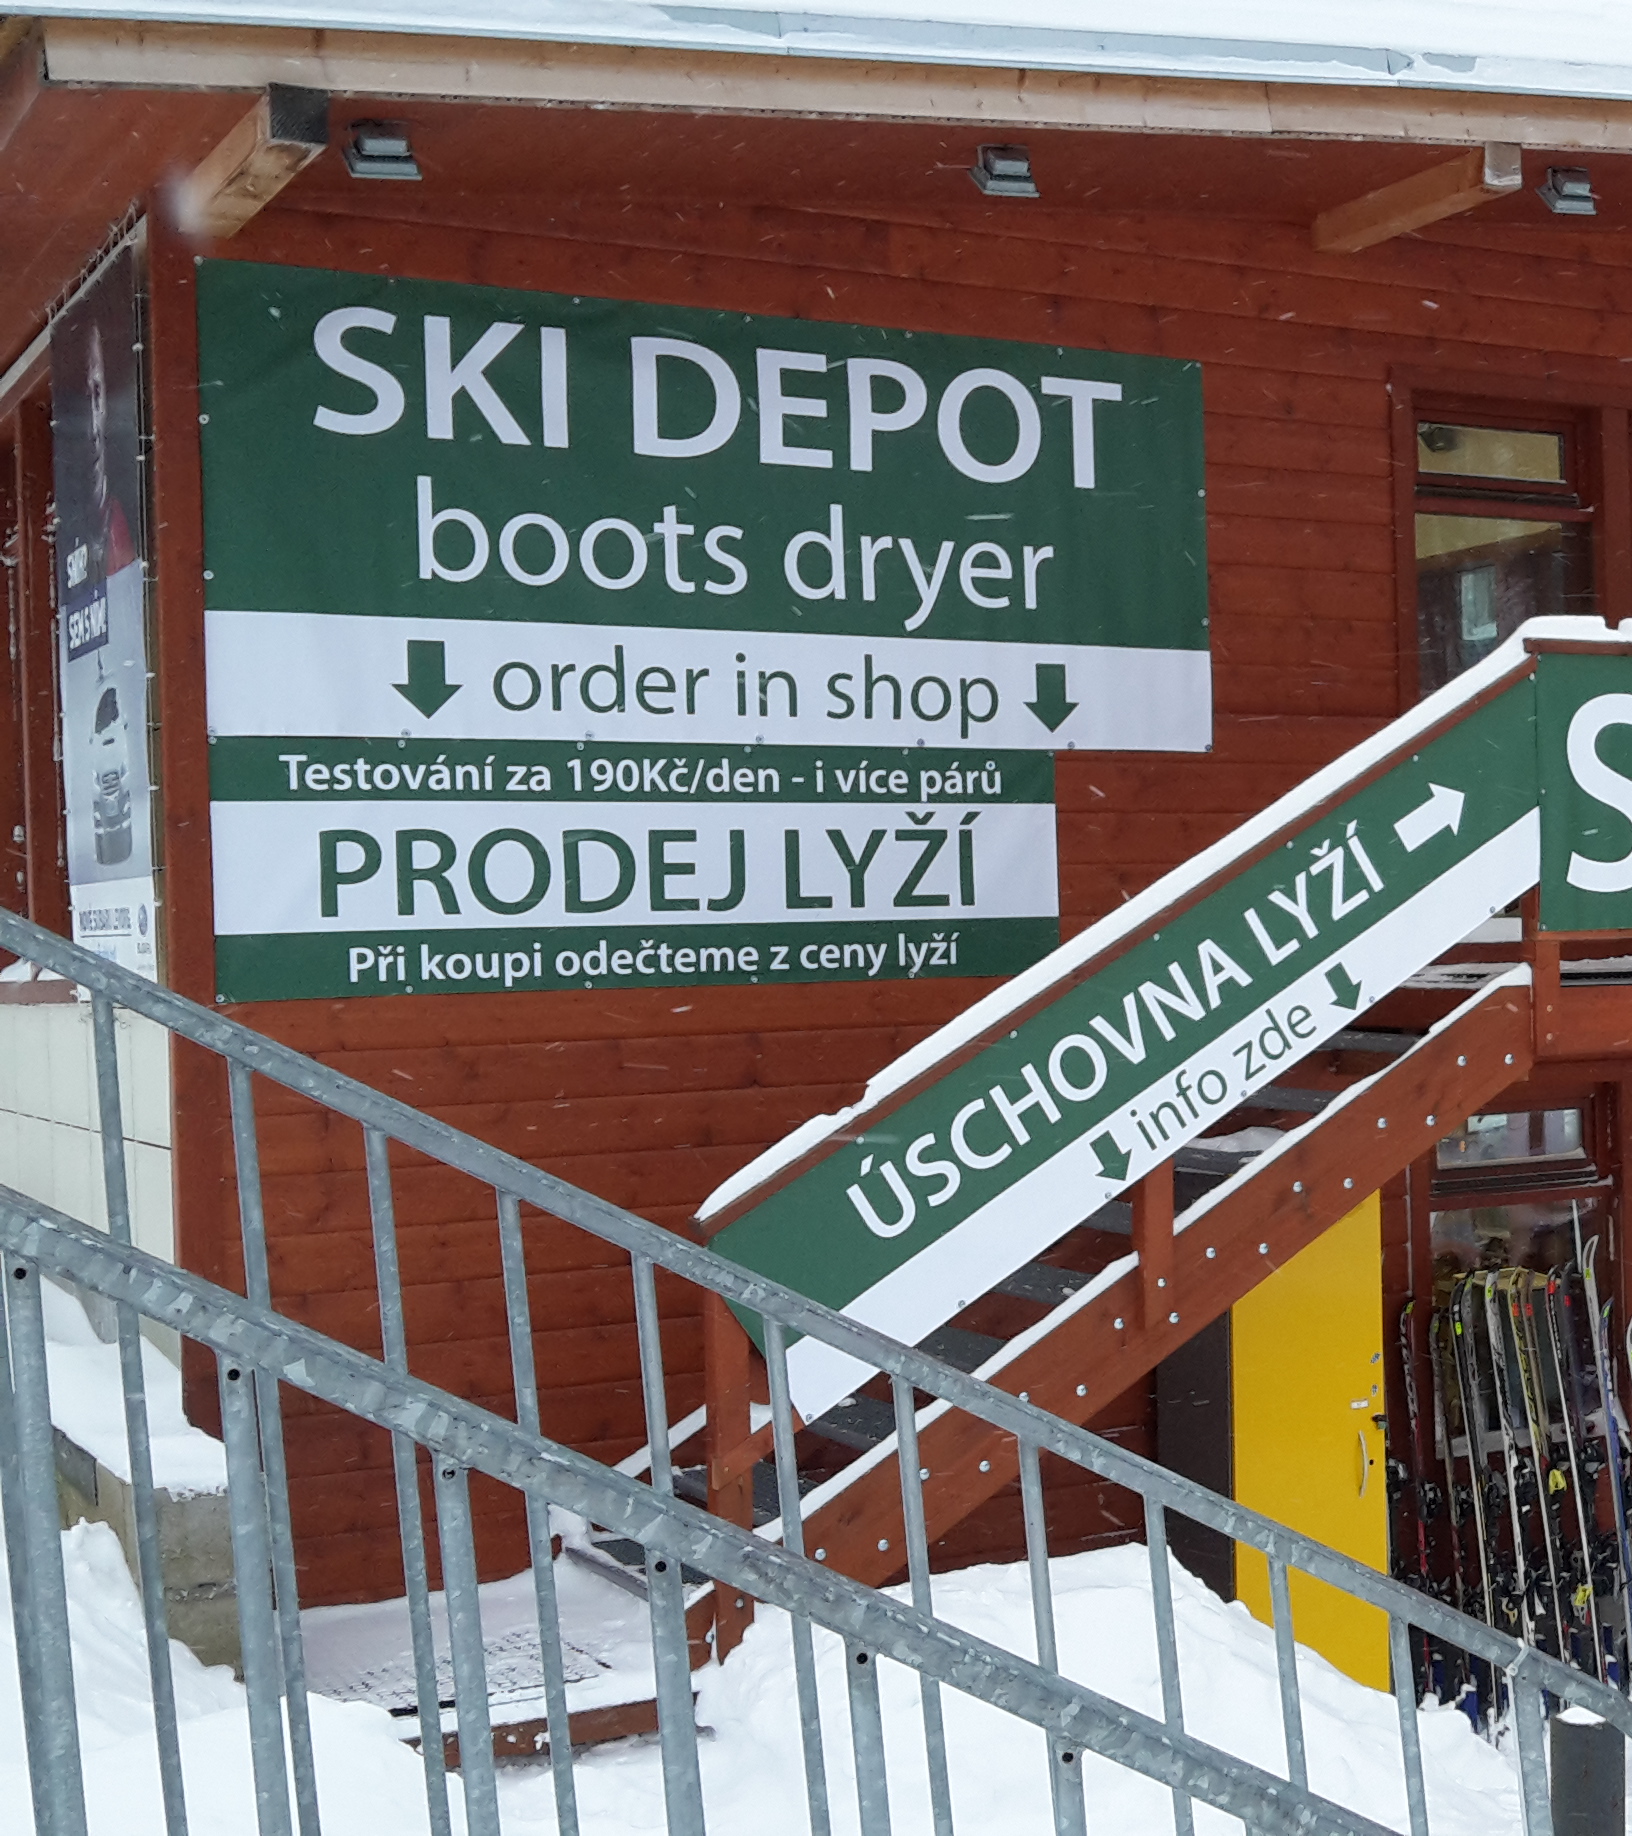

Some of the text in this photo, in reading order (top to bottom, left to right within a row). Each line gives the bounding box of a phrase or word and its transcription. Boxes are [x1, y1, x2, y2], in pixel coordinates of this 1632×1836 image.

[313, 306, 1123, 490] SKI DEPOT
[416, 475, 1054, 632] boots dryer
[492, 644, 999, 740] order in shop
[278, 754, 496, 791] Testování
[505, 765, 552, 792] za
[566, 757, 780, 794] 190Kč/den
[815, 759, 824, 793] i
[834, 758, 909, 794] více
[919, 760, 1002, 803] párů
[318, 811, 982, 918] PRODEJ LYŽÍ
[348, 932, 957, 988] Při koupi odečteme z ceny lyží
[845, 819, 1385, 1238] ÚSCHOVNA LYŽÍ
[1136, 1004, 1317, 1151] info zde
